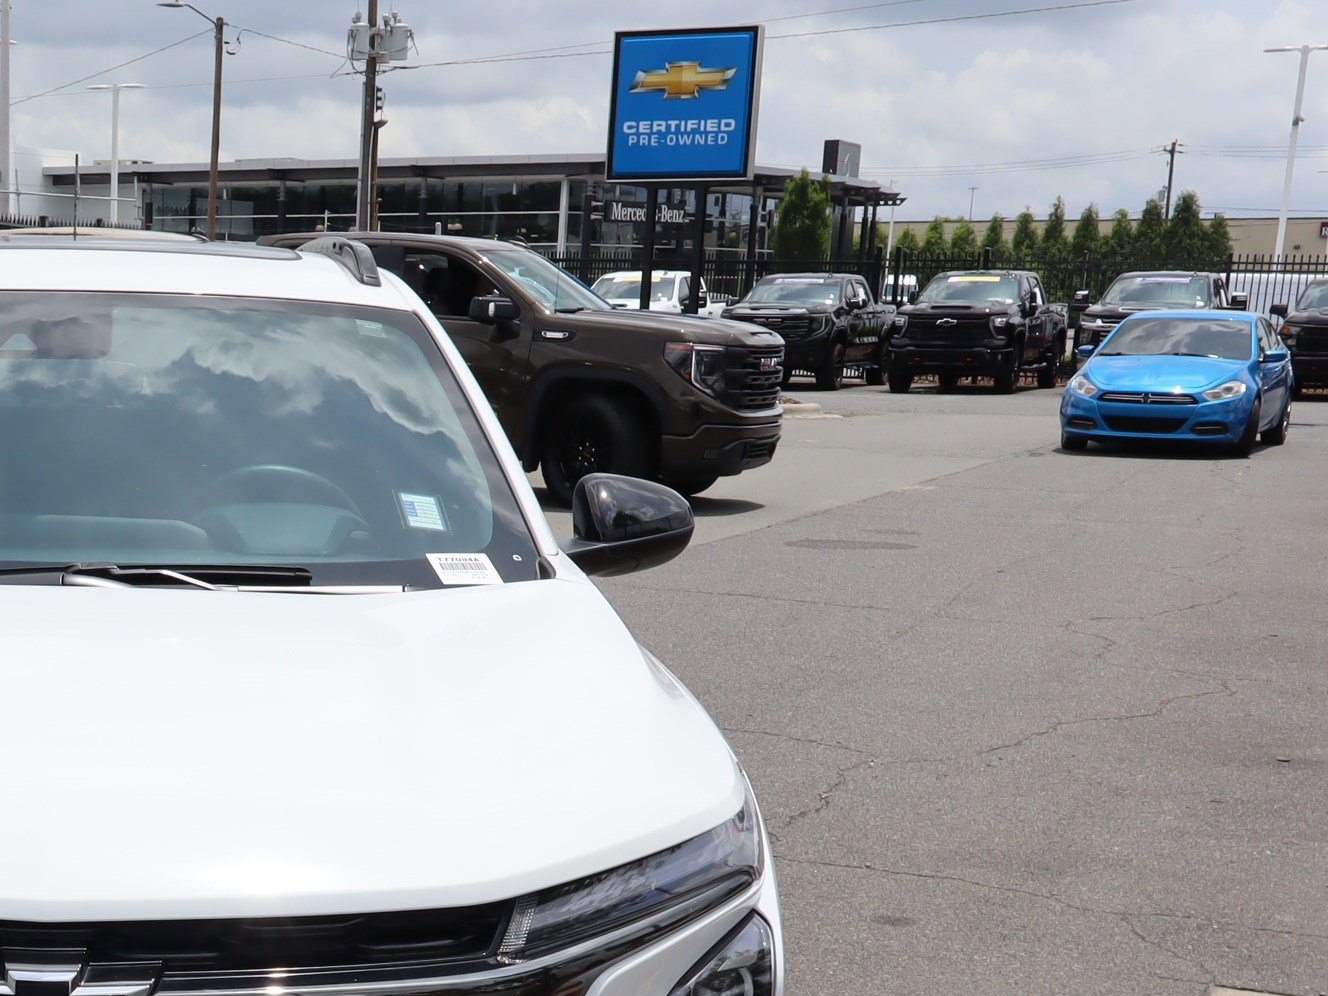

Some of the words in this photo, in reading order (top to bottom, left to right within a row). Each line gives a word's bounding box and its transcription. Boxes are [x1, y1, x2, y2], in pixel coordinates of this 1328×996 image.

[623, 118, 736, 133] CERTIFIED
[628, 132, 728, 146] PRE-OWNED
[611, 202, 685, 223] Merced-Benz
